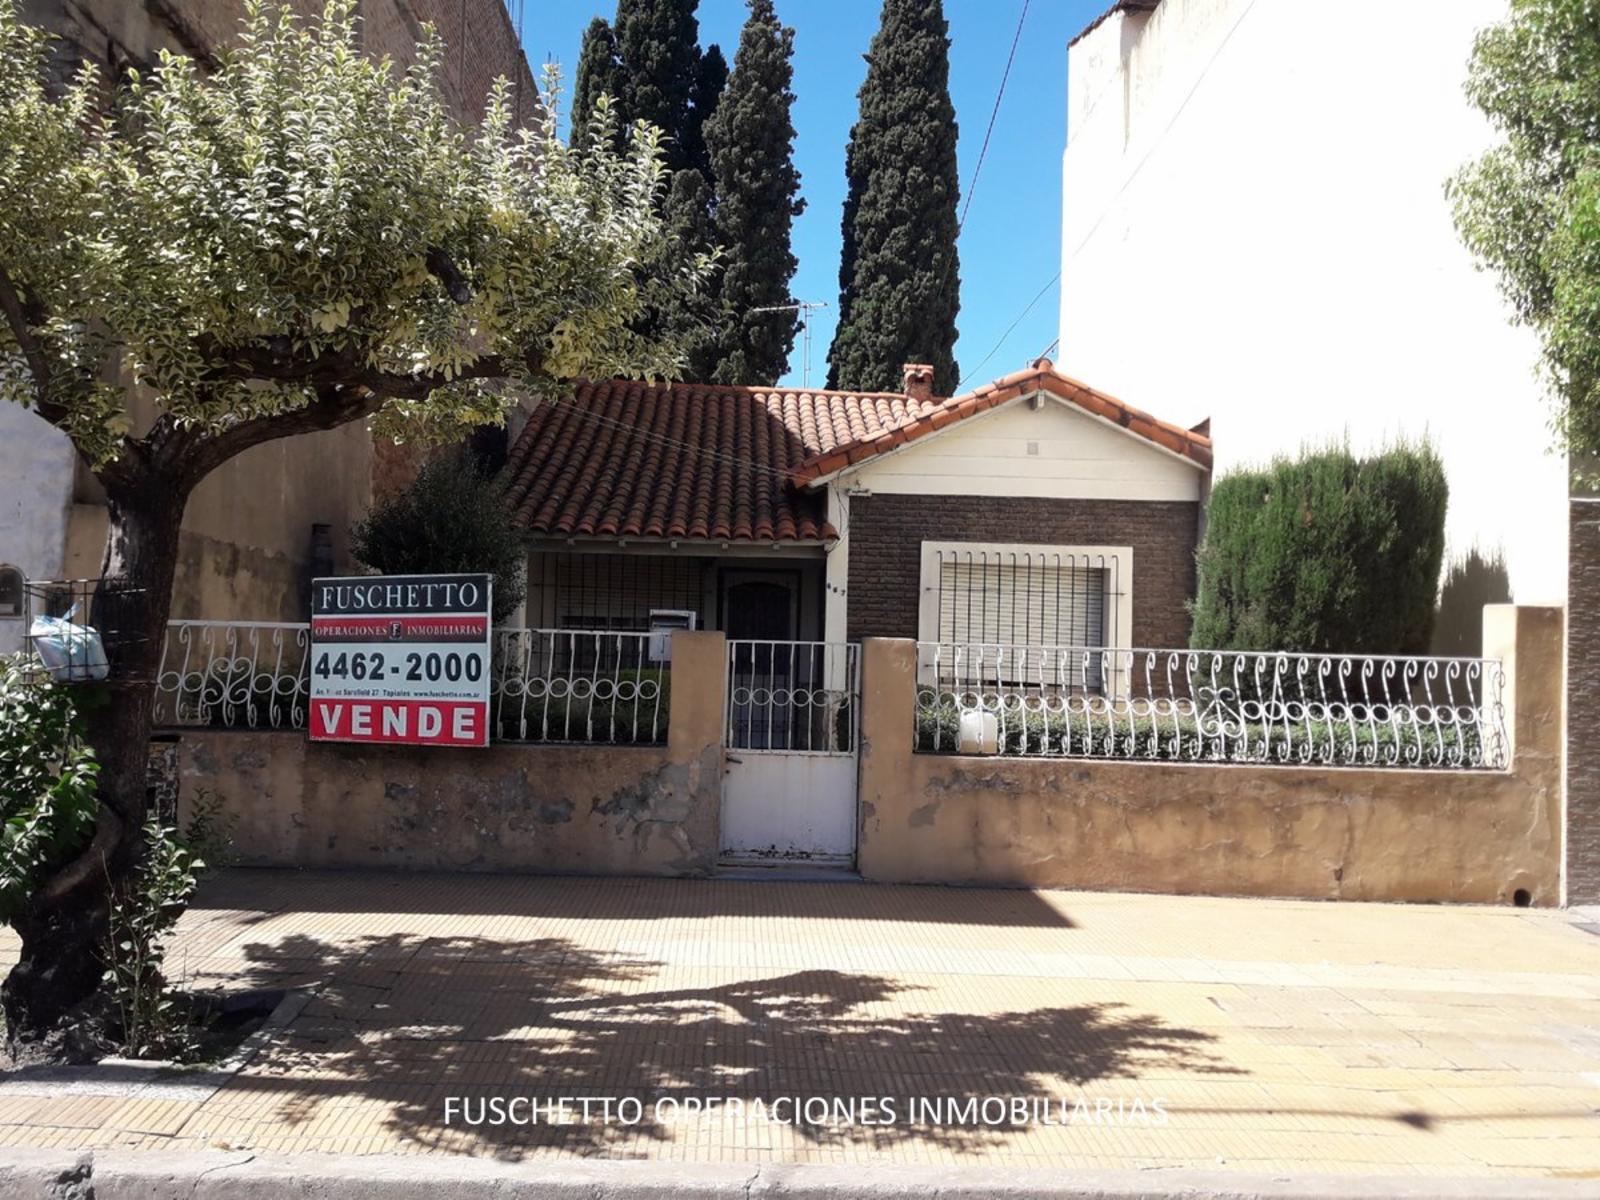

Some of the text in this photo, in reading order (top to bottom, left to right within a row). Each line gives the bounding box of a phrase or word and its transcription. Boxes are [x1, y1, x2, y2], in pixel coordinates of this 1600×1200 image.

[321, 582, 478, 609] FUSCHETTO
[315, 626, 388, 636] OPERACIONES
[407, 625, 483, 636] INMOBILIARIAS
[319, 704, 476, 740] VENDE
